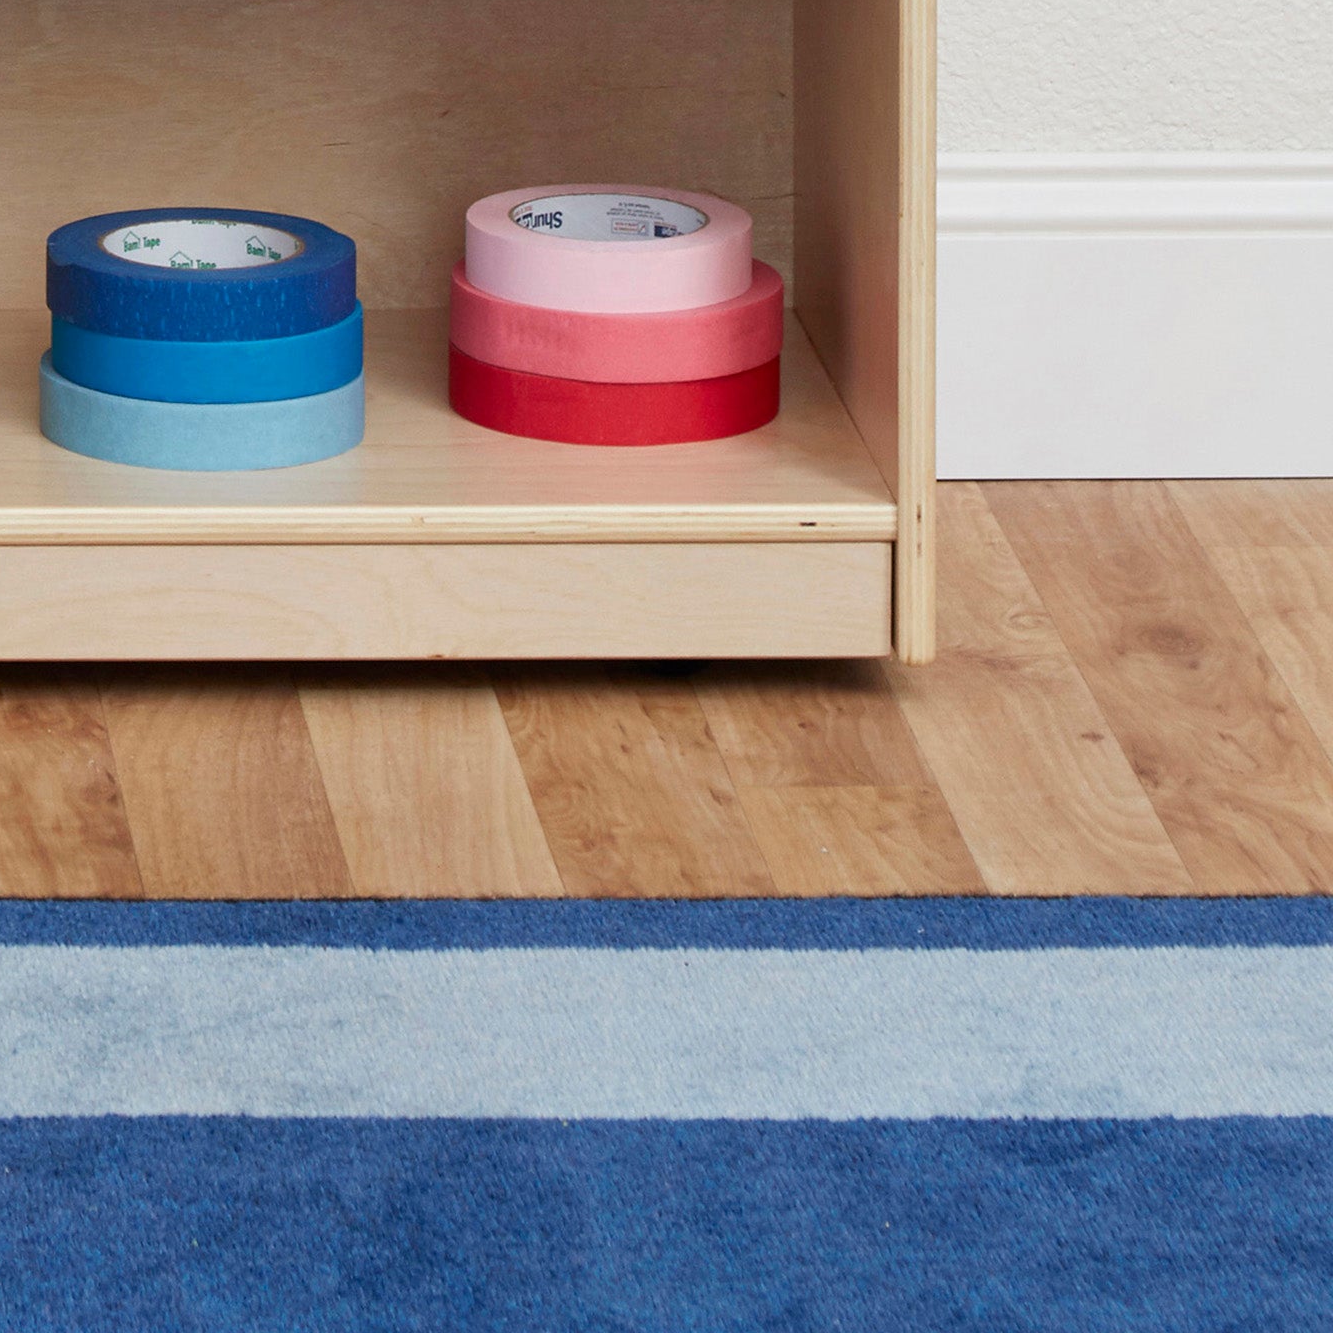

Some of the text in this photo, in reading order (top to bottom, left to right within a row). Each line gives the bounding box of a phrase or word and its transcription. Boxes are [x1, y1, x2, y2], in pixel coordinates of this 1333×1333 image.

[124, 236, 161, 252] Bam! Tape
[246, 244, 267, 257] Bam!
